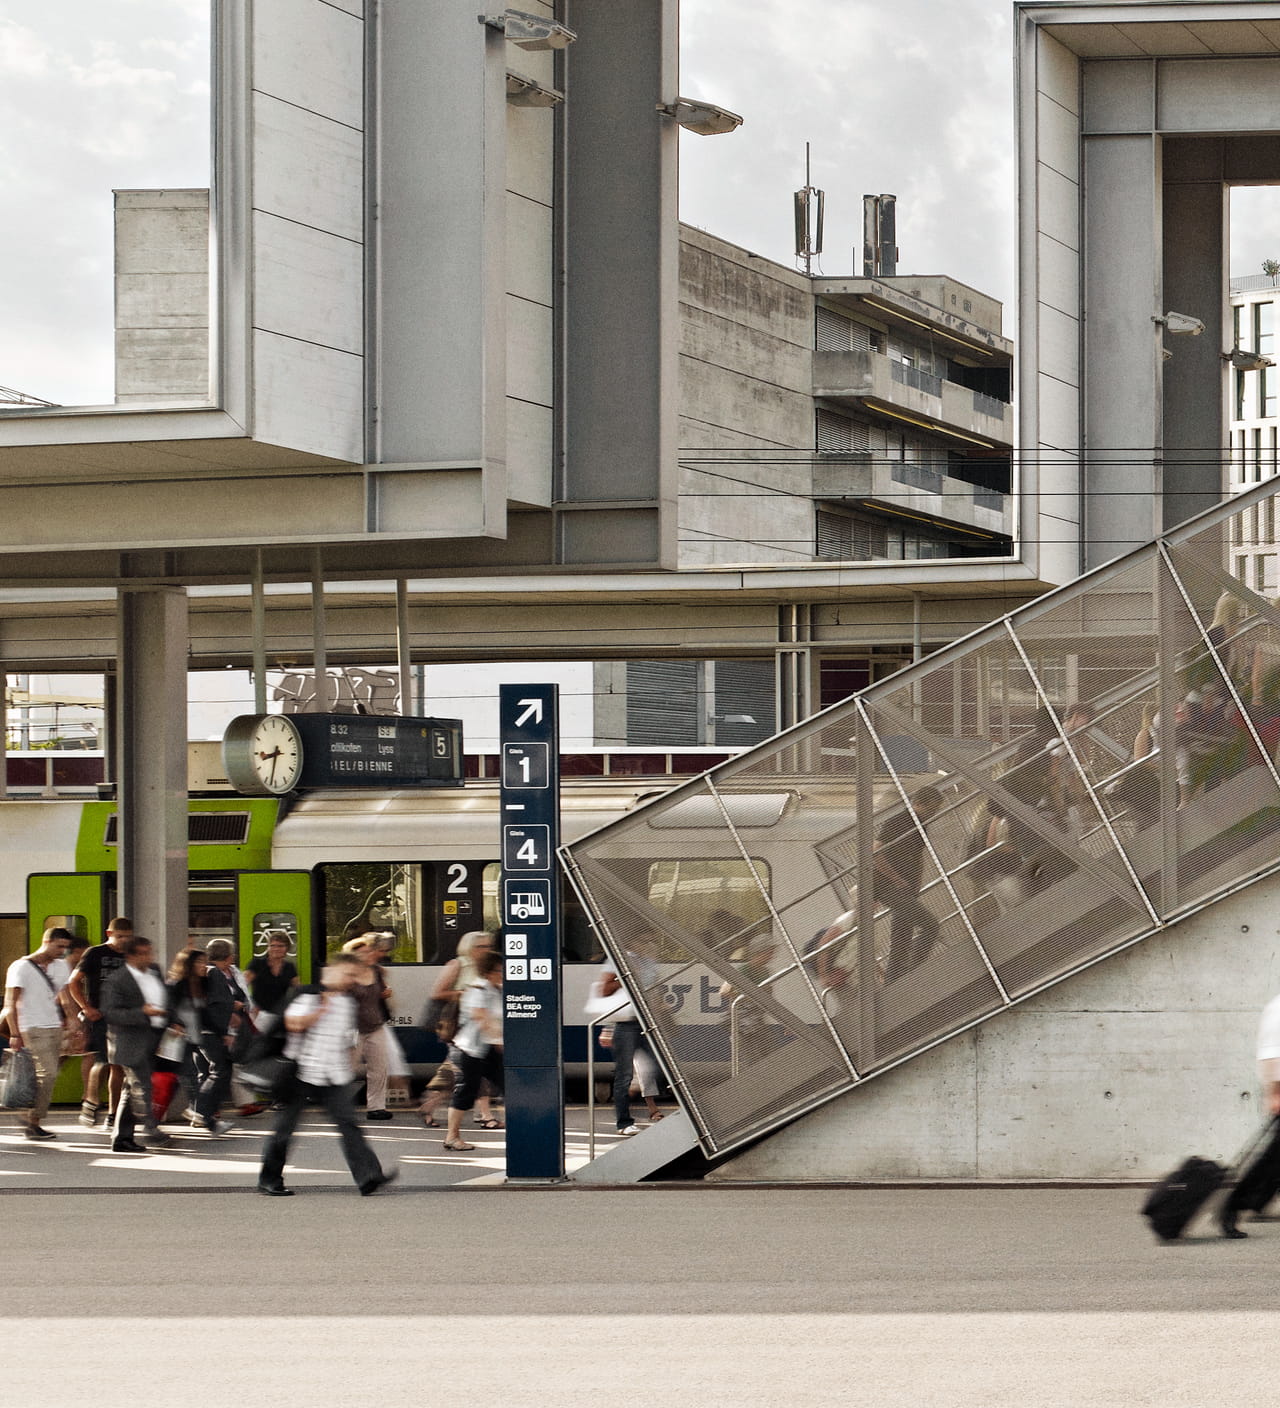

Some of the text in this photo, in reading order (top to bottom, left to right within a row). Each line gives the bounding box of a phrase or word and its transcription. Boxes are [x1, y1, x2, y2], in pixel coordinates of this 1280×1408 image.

[330, 742, 394, 755] ollikofen Lyss
[437, 737, 446, 756] 5
[518, 756, 530, 783] 1
[516, 838, 538, 865] 4
[447, 863, 469, 894] 2
[509, 940, 524, 950] 20
[509, 965, 524, 975] 28
[533, 965, 548, 975] 40
[522, 1003, 542, 1012] expo
